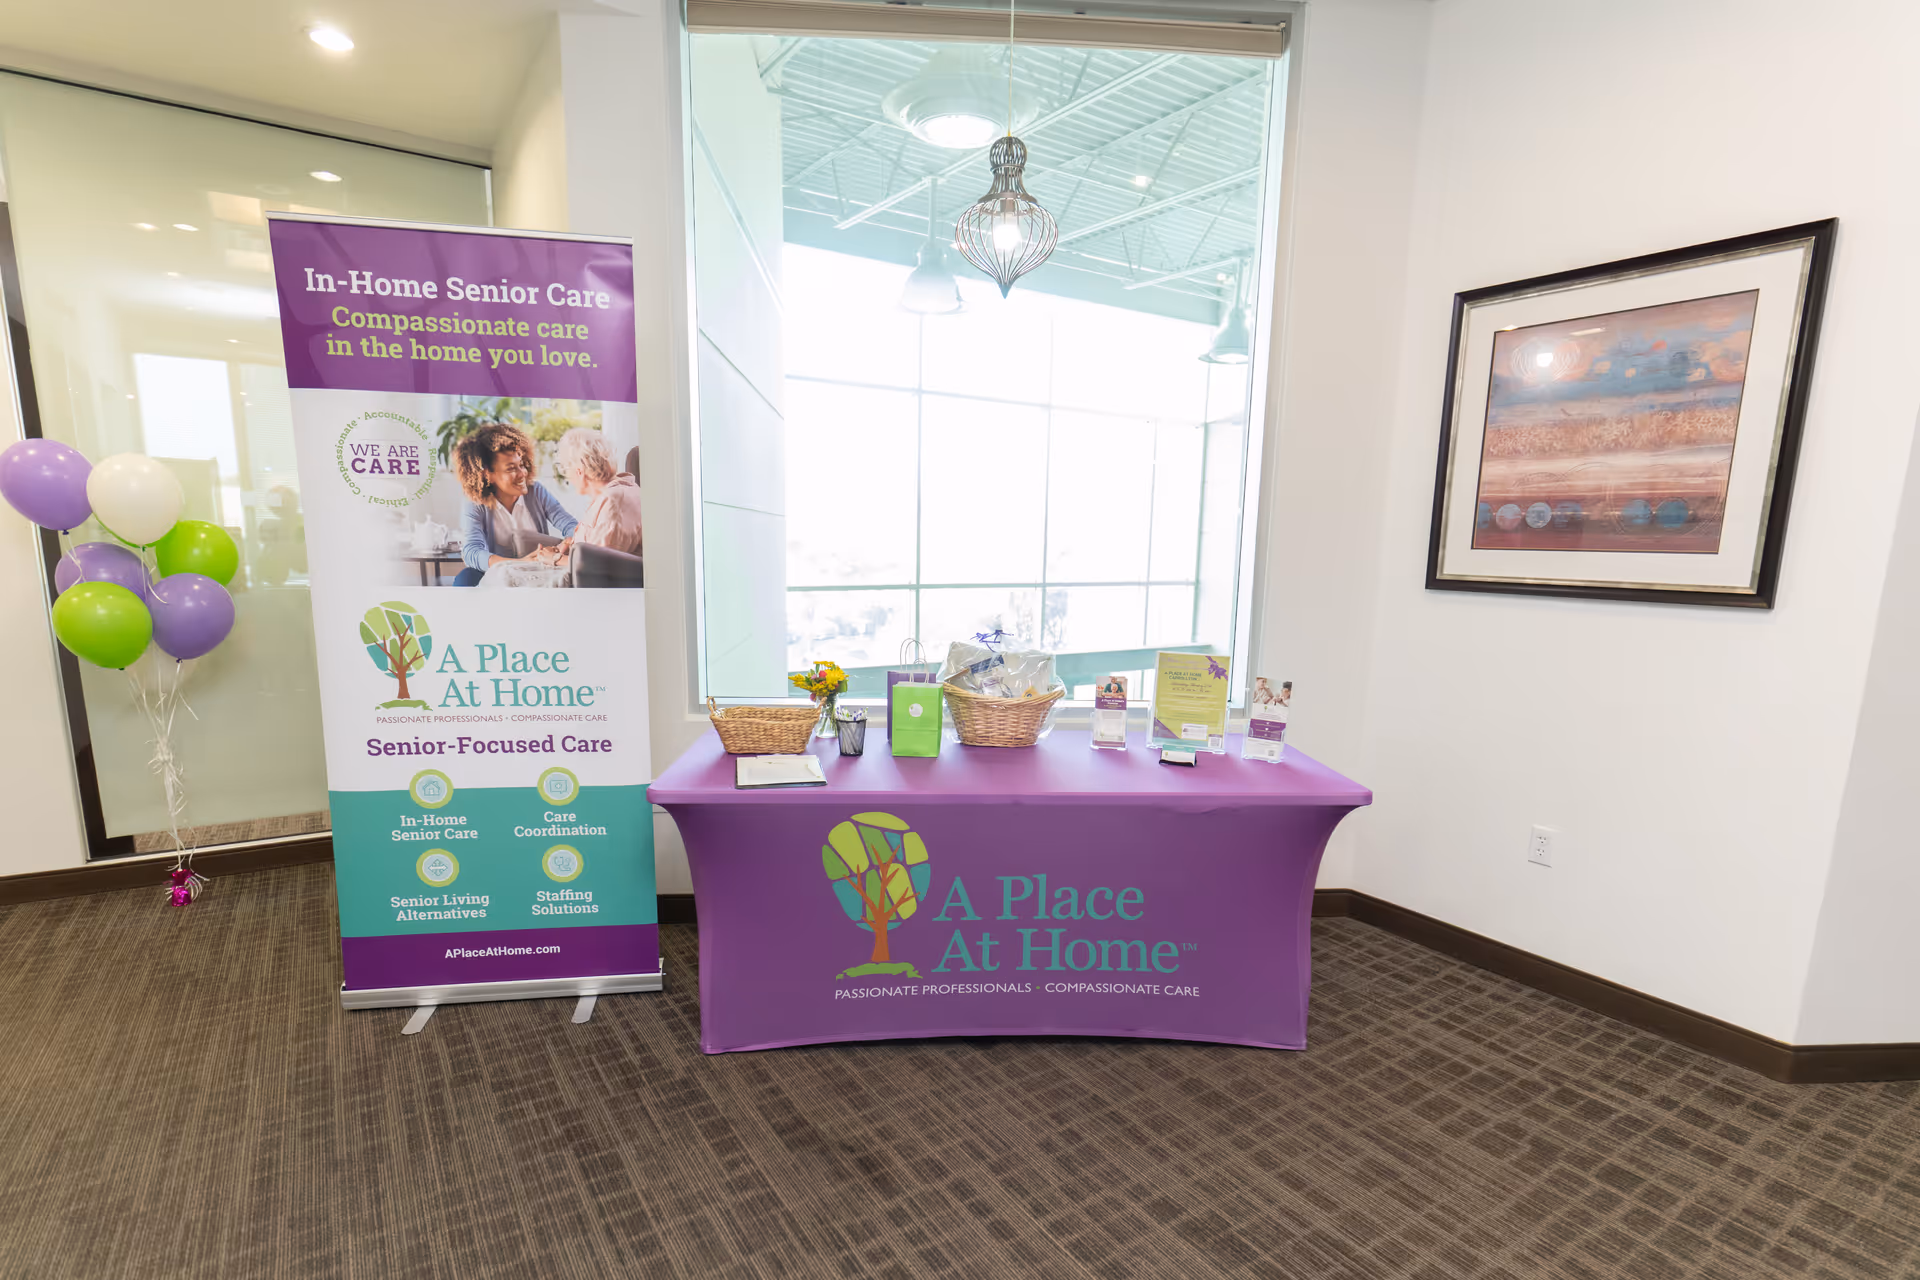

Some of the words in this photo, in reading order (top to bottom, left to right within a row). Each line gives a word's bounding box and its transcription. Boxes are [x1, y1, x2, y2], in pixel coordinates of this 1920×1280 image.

[304, 267, 438, 299] In-Home
[446, 276, 539, 305] Senior
[546, 282, 610, 309] Care
[331, 305, 530, 338] Compassionate
[536, 319, 589, 340] care
[326, 333, 353, 357] in
[360, 335, 402, 360] the
[409, 338, 481, 363] home
[488, 346, 534, 368] you
[540, 344, 598, 368] love.
[364, 411, 428, 441] Accountable
[335, 419, 361, 495] Compassionate
[349, 444, 380, 456] WE
[387, 445, 419, 458] ARE
[351, 458, 420, 476] CARE
[436, 644, 467, 674] A
[474, 642, 570, 674] Place
[438, 678, 482, 708] At
[376, 715, 432, 724] PASSIONATE
[434, 714, 504, 723] PROFESSIONALS
[510, 714, 584, 722] COMPASSIONATE
[366, 734, 556, 756] Senior-Focused
[561, 735, 612, 754] Care
[400, 814, 468, 827] In-Home
[544, 811, 576, 822] Care
[391, 828, 440, 841] Senior
[444, 828, 478, 840] Care
[514, 824, 608, 837] Coordination
[390, 895, 440, 908] Senior
[442, 893, 490, 907] Living
[536, 889, 593, 903] Staffing
[932, 876, 983, 922] A
[996, 873, 1145, 922] Place
[396, 907, 488, 922] Alternatives
[531, 903, 599, 916] Solutions
[444, 944, 561, 959] APlaceAtHome.com
[931, 929, 1000, 973] At
[834, 985, 918, 1000] PASSIONATE
[922, 982, 1032, 996] PROFESSIONALS
[1044, 982, 1160, 996] COMPASSIONATE
[1164, 984, 1200, 998] CARE
